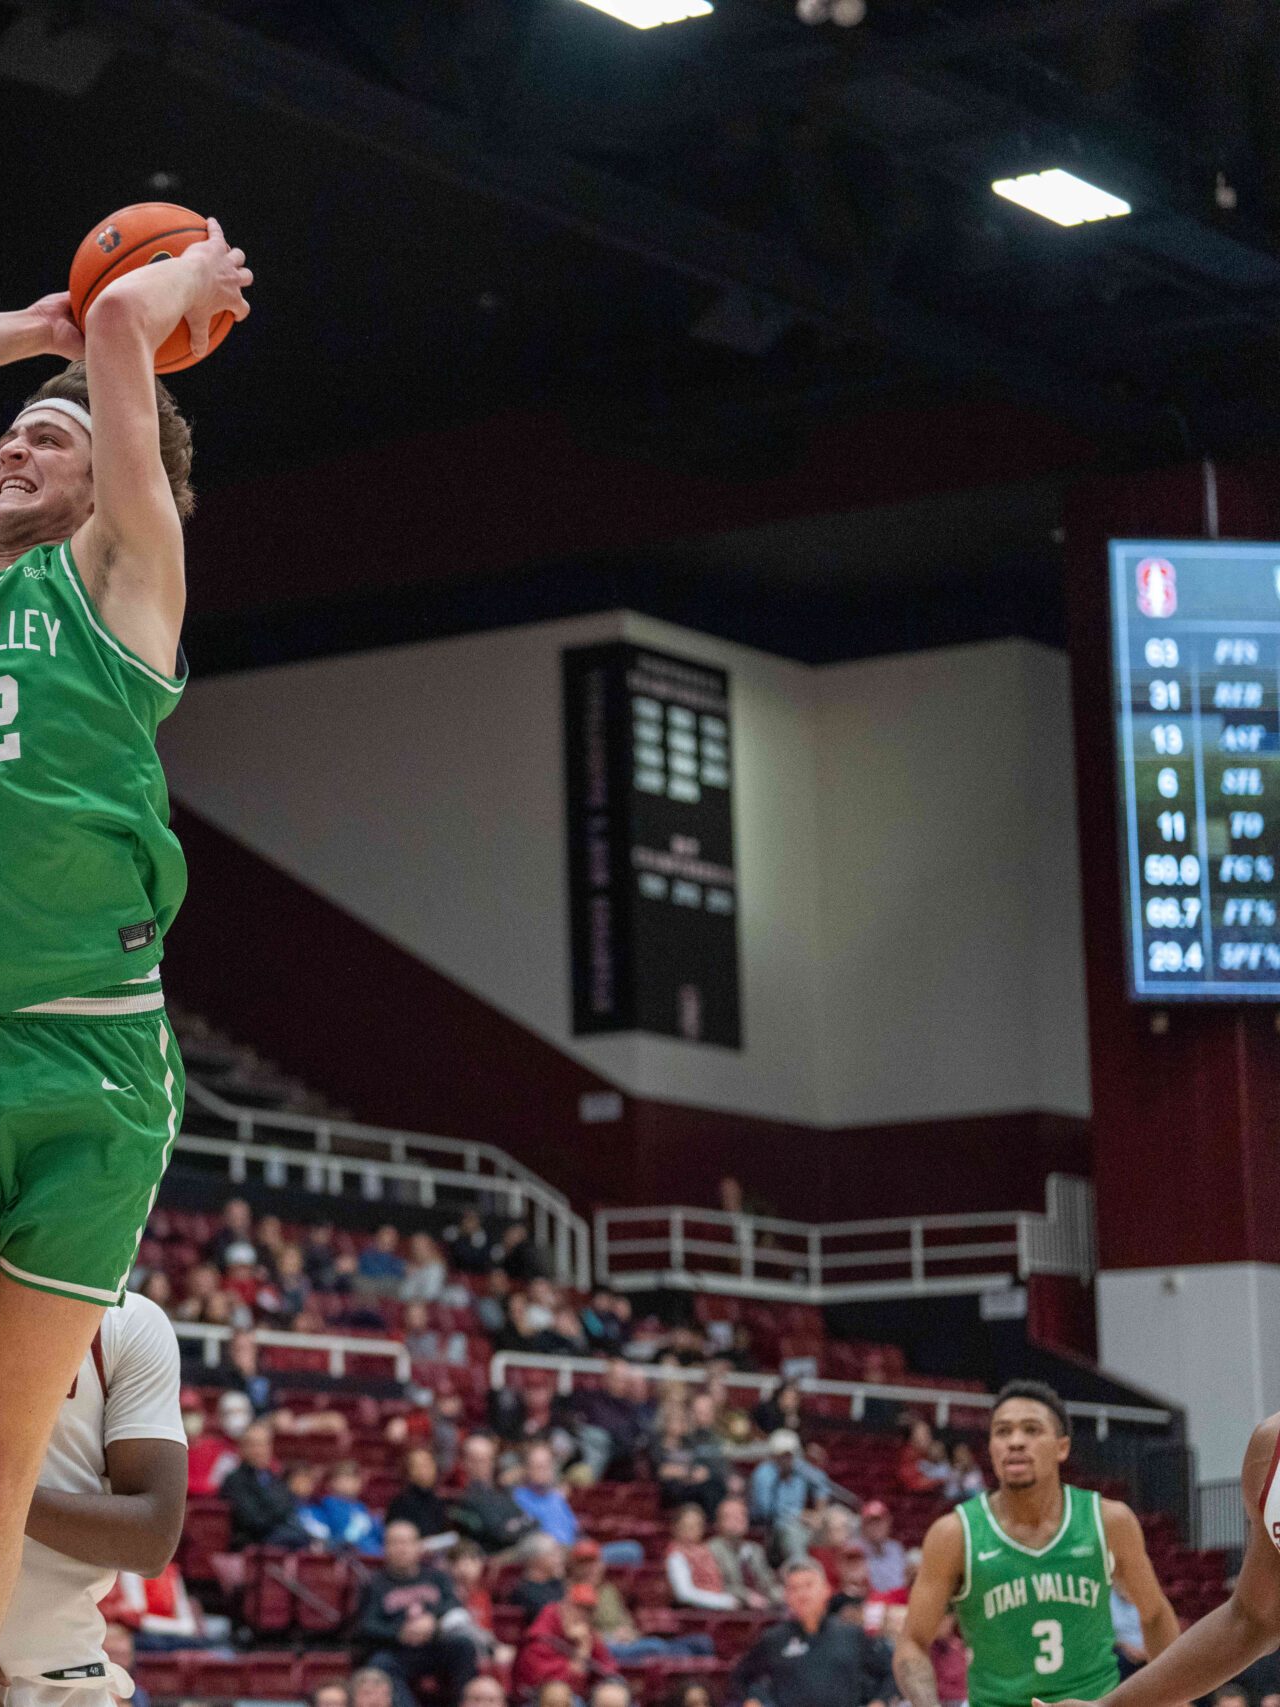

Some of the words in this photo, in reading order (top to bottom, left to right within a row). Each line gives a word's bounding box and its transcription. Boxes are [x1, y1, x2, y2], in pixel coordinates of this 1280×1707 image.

[1145, 638, 1179, 668] 63
[1149, 680, 1180, 710] 31
[1157, 767, 1179, 798] 6
[1157, 811, 1186, 842] 11
[983, 1576, 1028, 1619] UTAH
[1031, 1572, 1101, 1609] VALLEY
[1031, 1618, 1064, 1675] 3
